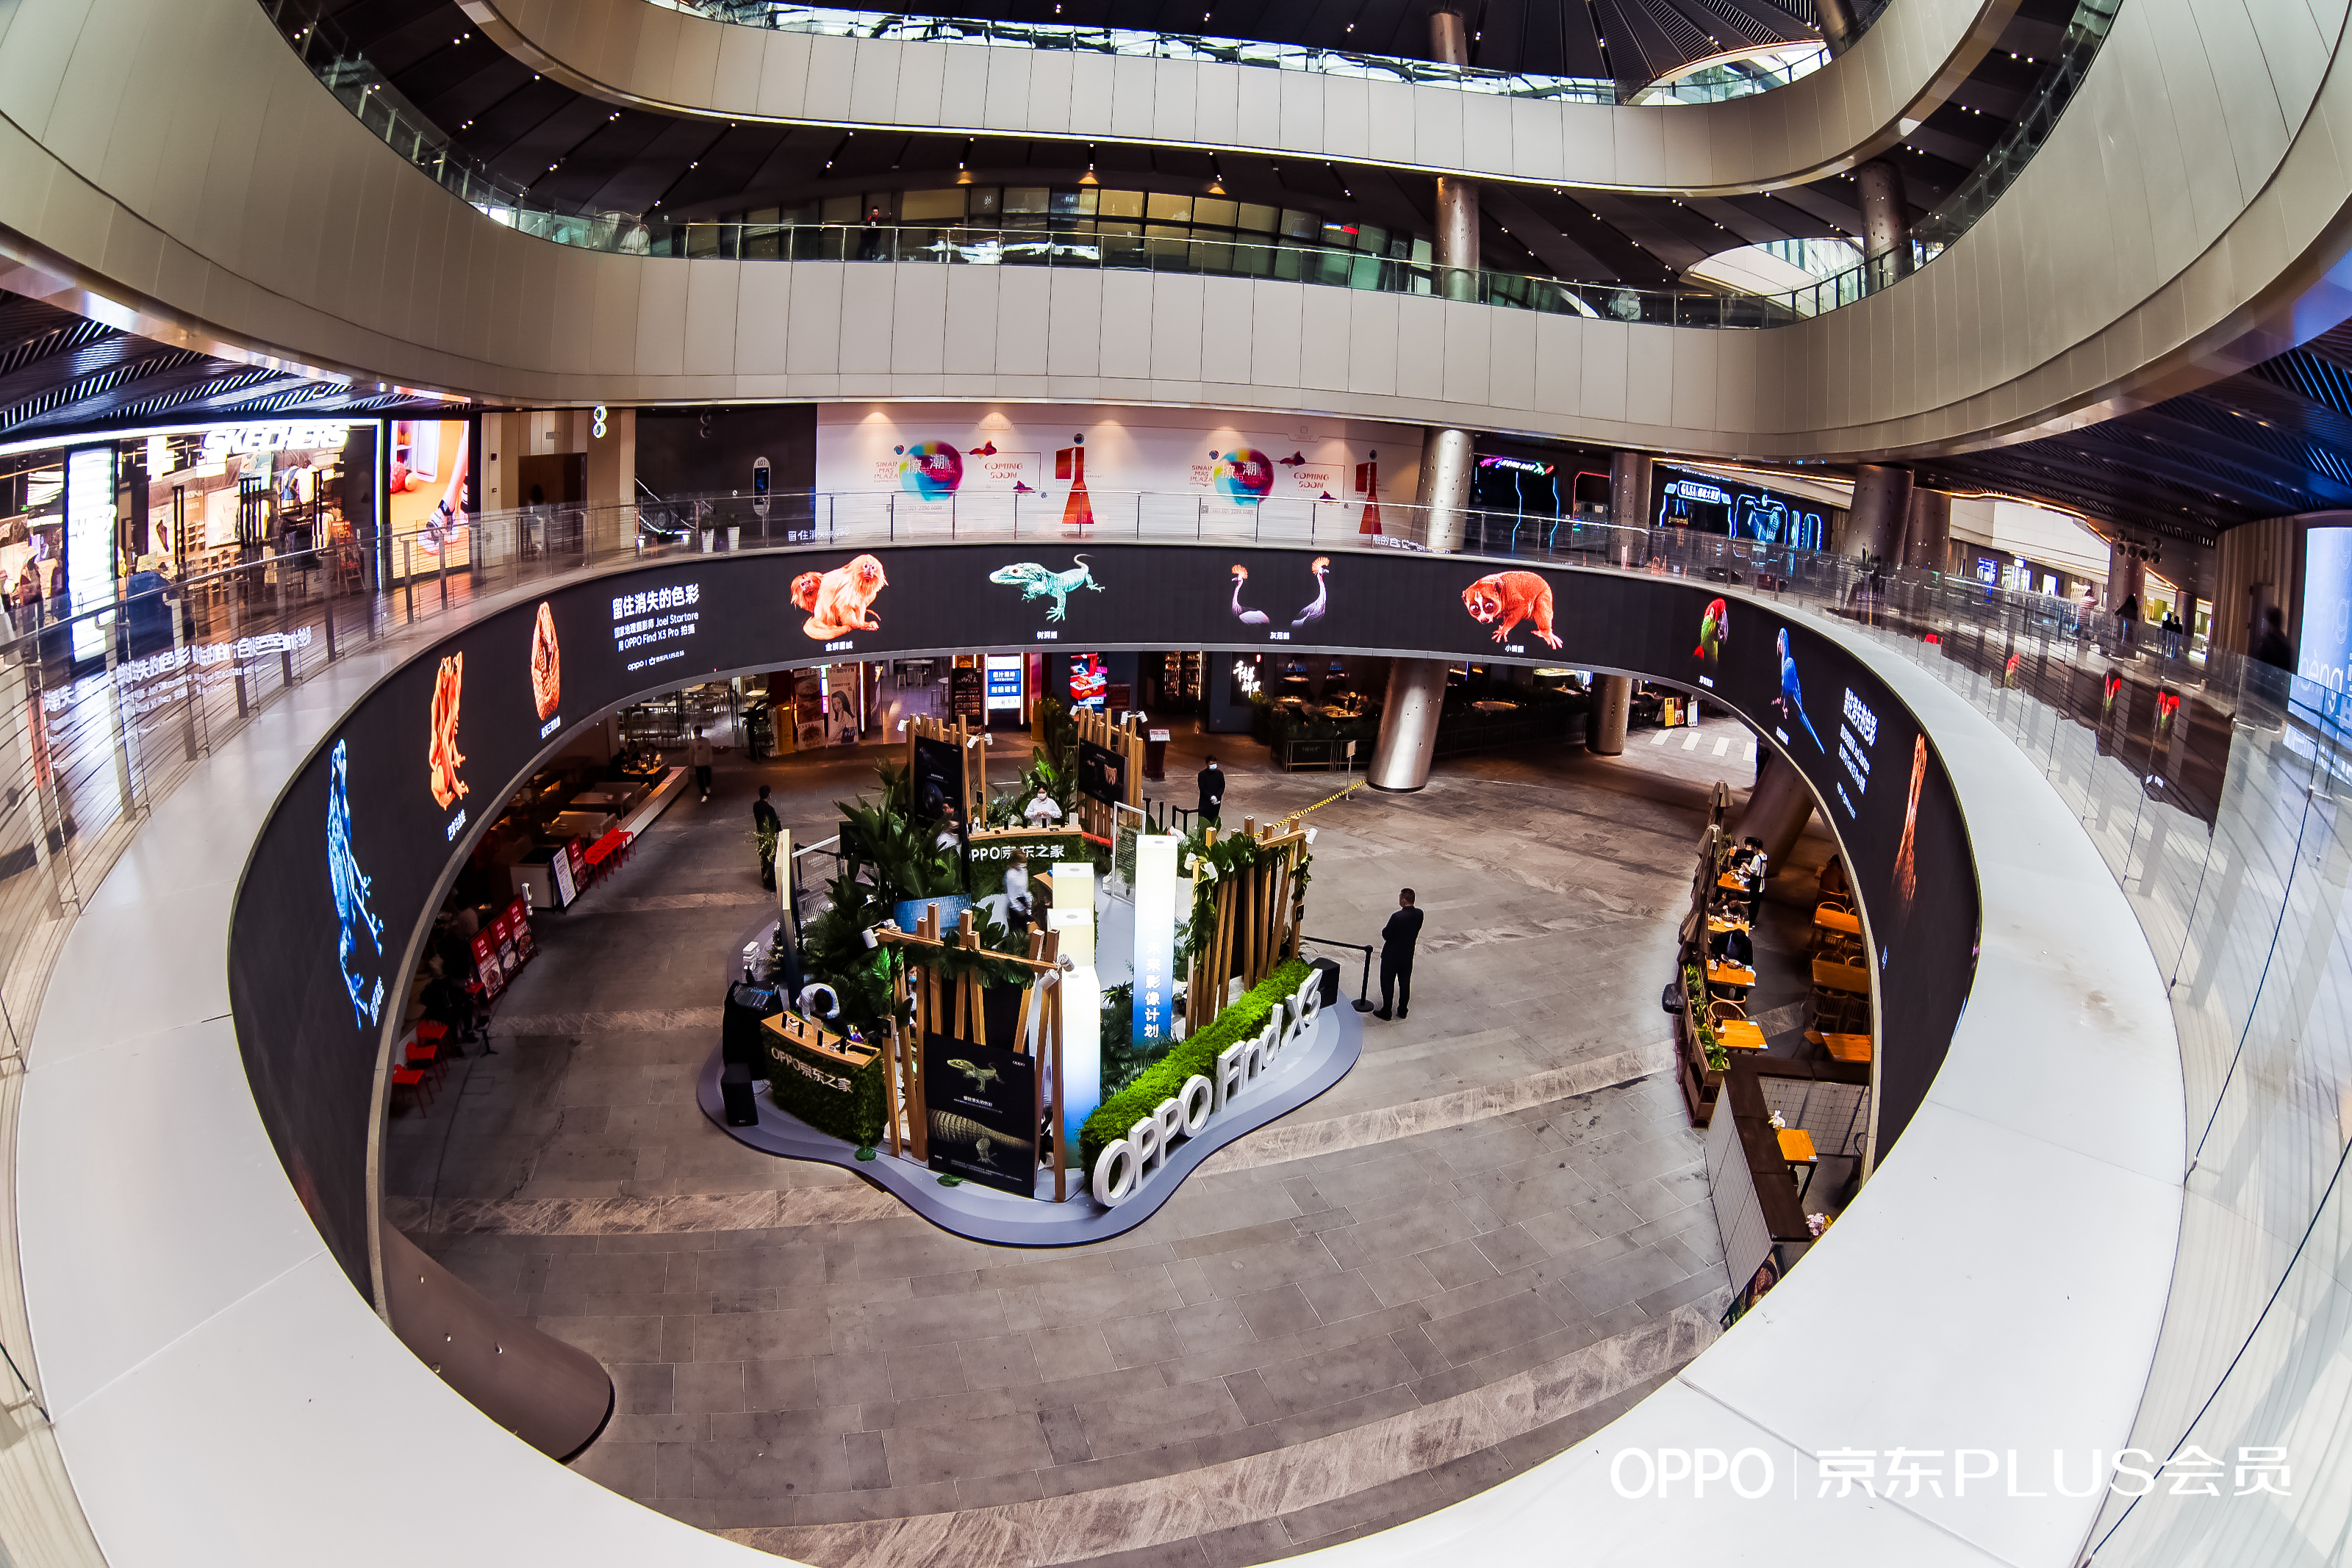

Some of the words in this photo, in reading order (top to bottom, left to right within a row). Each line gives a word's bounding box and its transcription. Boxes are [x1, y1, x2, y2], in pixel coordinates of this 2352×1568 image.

[203, 425, 350, 454] SKECHERS
[984, 462, 1023, 470] COMING
[1294, 472, 1329, 481] COMING
[612, 583, 699, 619] 留住消失的色彩
[656, 615, 669, 627] Joel
[670, 612, 699, 624] Startore
[625, 636, 642, 648] OPPO
[642, 631, 657, 644] Find
[658, 630, 666, 640] X3
[667, 628, 679, 638] Pro
[969, 847, 1000, 861] PPO
[1144, 941, 1162, 1038] 未来影像计划
[772, 1047, 800, 1071] OPPO
[800, 1062, 853, 1093] 京东之家
[1093, 1074, 1212, 1207] OPPO
[1215, 1004, 1283, 1114] Find
[1280, 968, 1323, 1048] X3
